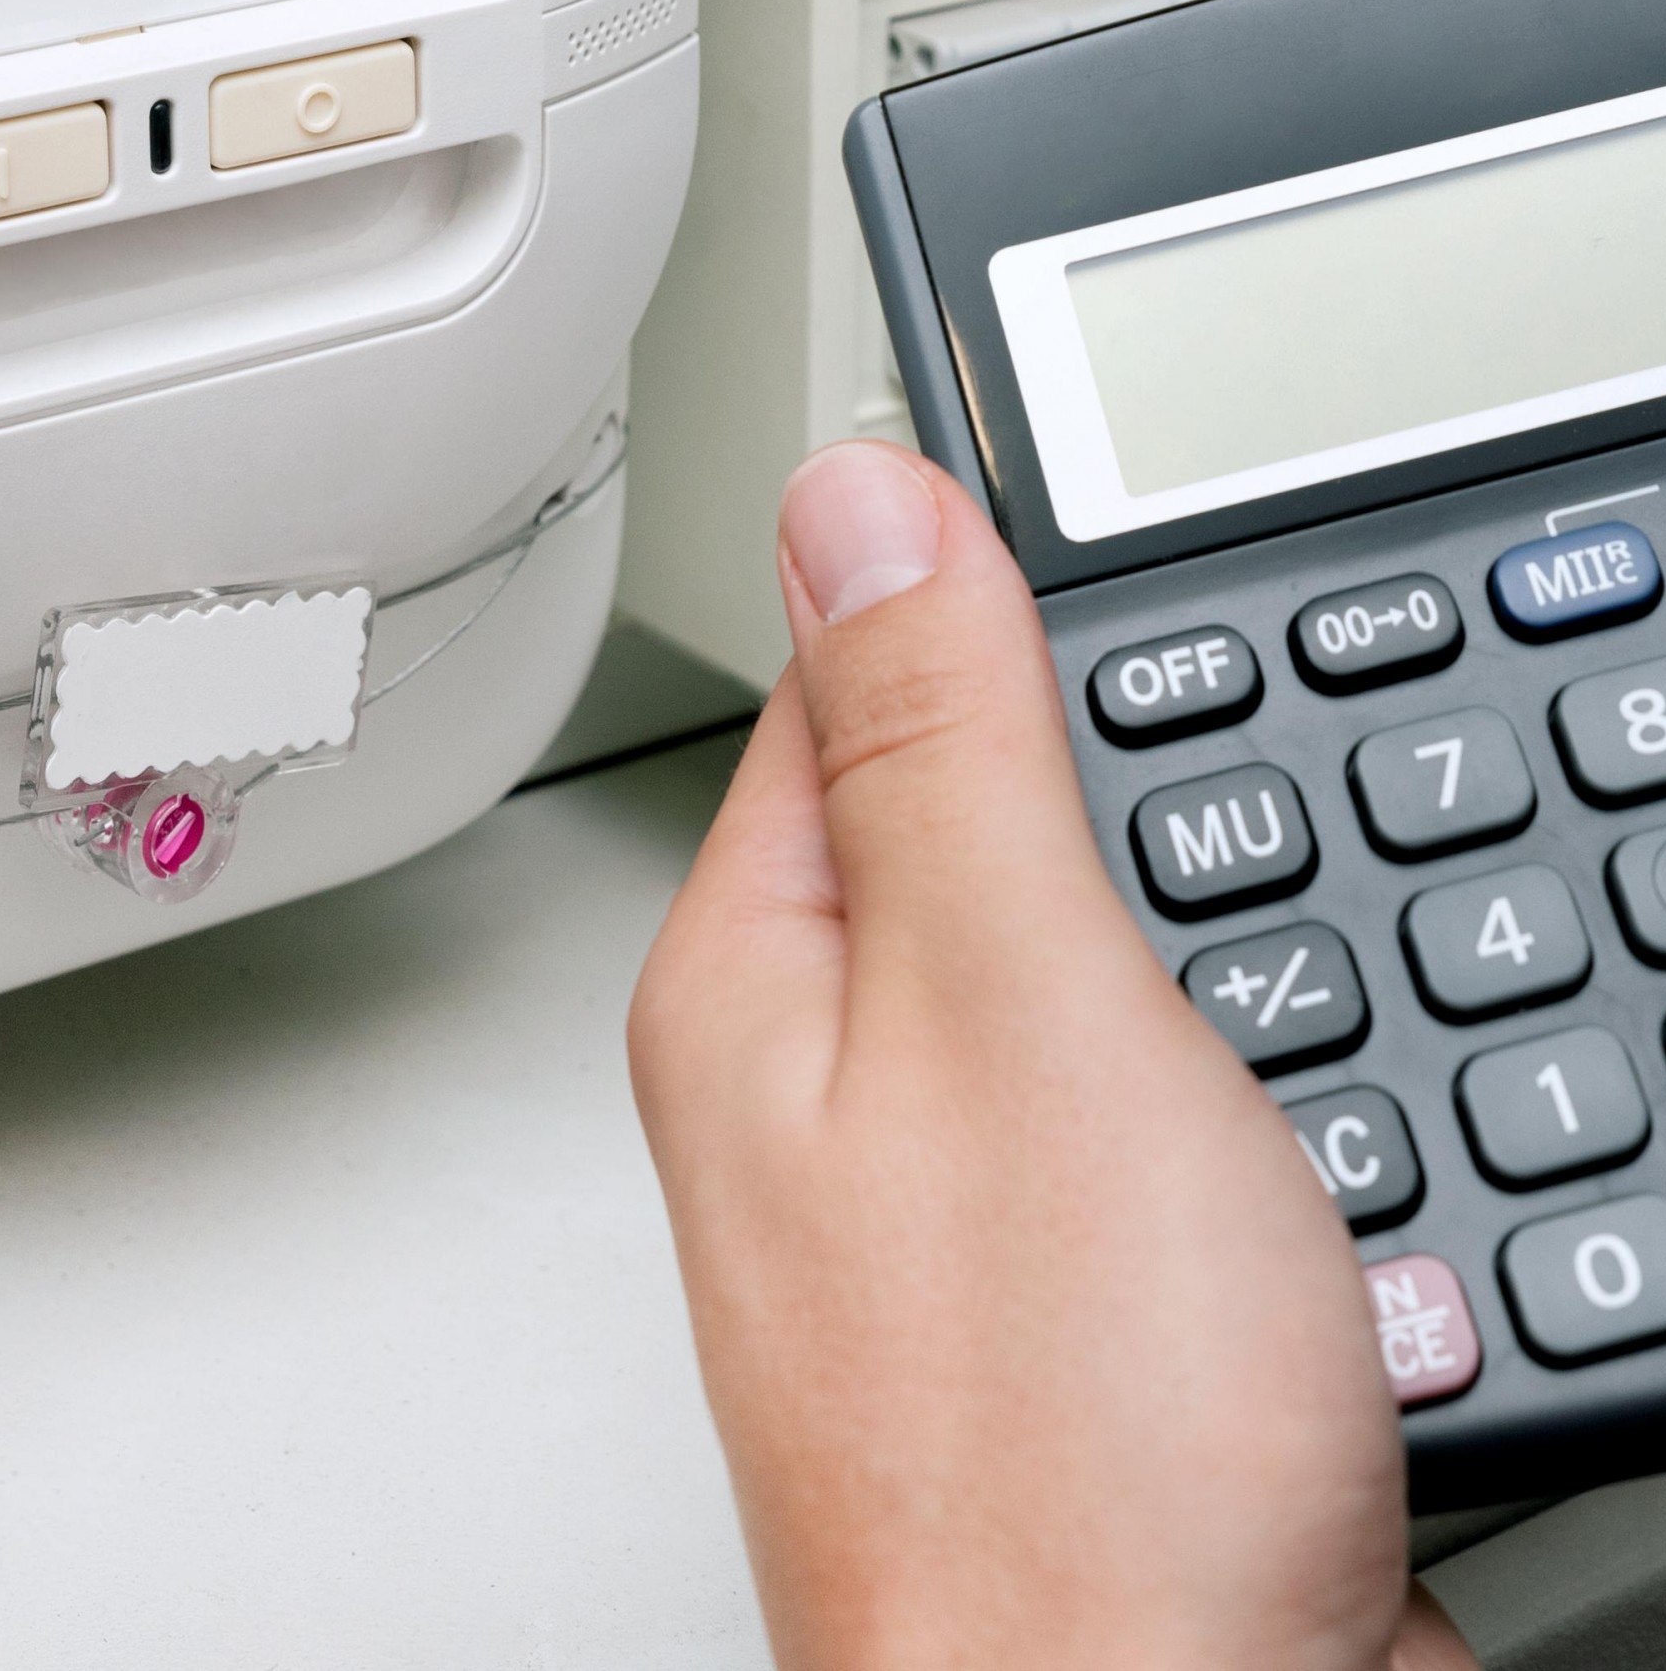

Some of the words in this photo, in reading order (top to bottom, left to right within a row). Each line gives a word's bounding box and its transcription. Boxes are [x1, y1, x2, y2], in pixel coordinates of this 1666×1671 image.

[1118, 637, 1231, 707] OFF
[1413, 737, 1464, 810] 7
[1165, 789, 1284, 877] MU
[1475, 896, 1535, 965] 4
[1536, 1062, 1580, 1134] 1
[1372, 1272, 1420, 1316] N
[1574, 1233, 1642, 1309] 0
[1381, 1318, 1457, 1379] CE
